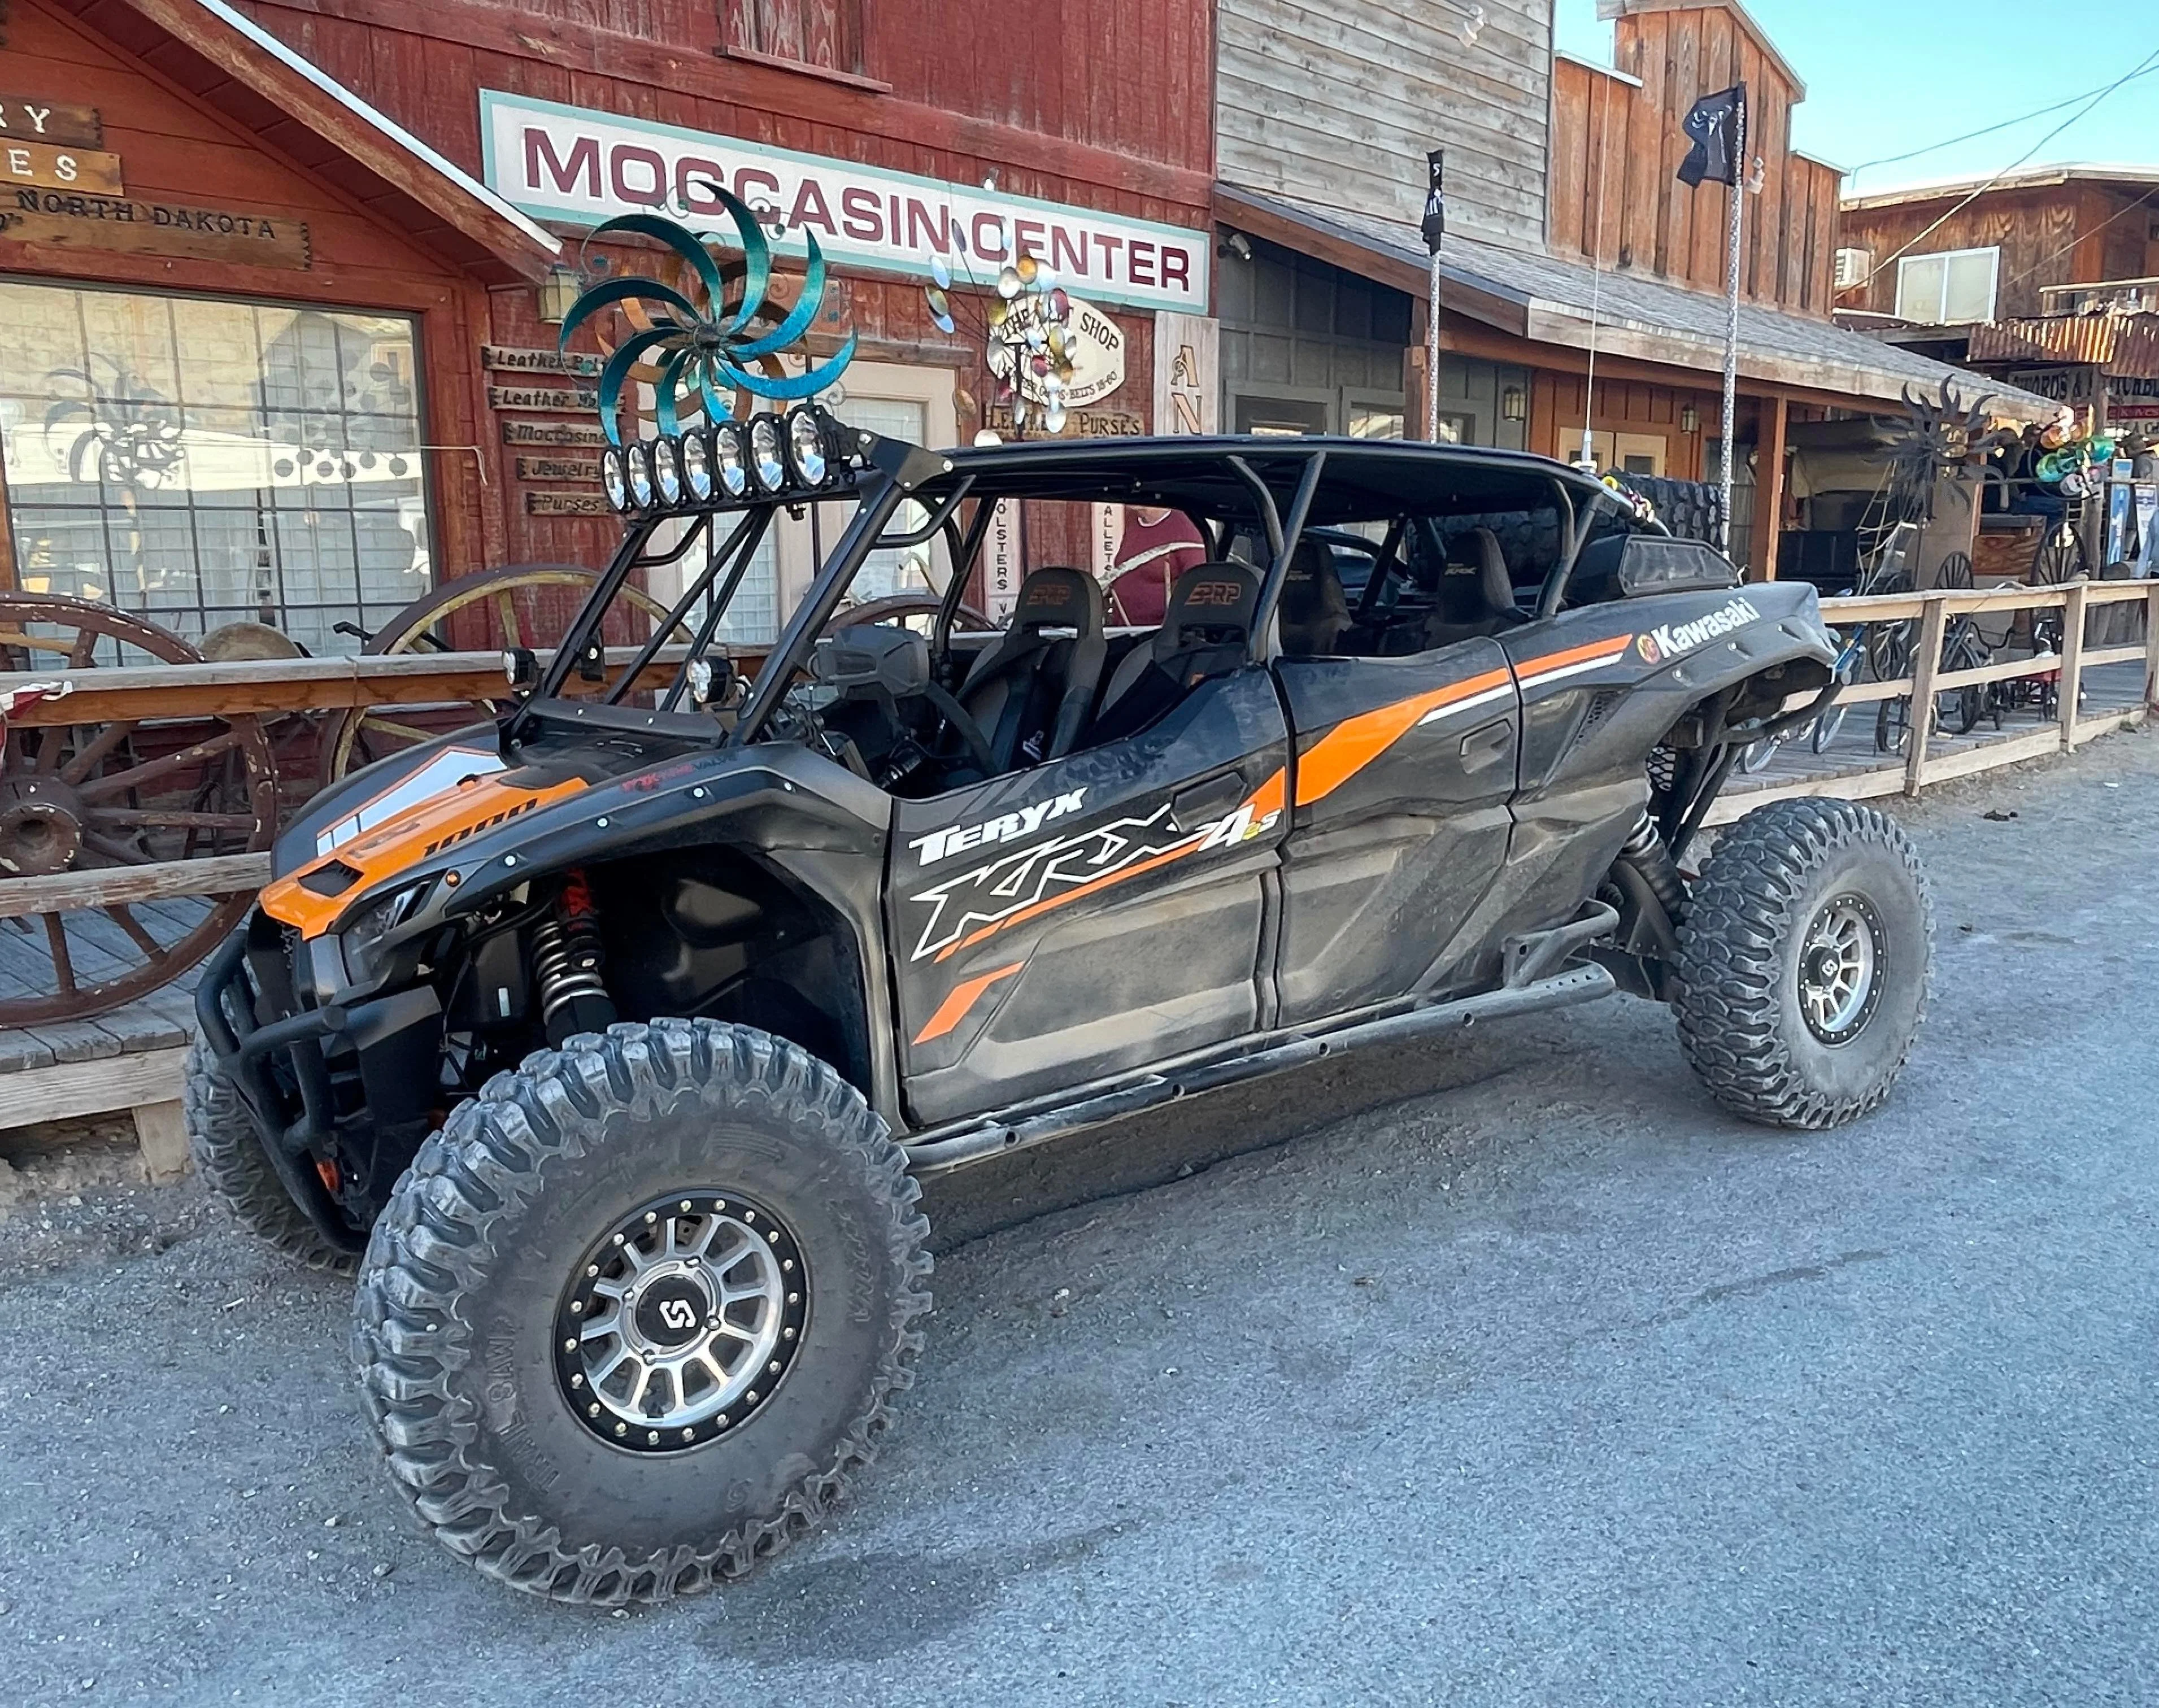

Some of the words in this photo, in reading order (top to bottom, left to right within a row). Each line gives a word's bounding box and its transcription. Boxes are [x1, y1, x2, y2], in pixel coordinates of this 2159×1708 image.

[17, 189, 135, 222] NORTH
[153, 207, 276, 239] DAKOTA
[524, 128, 950, 254] MOCCASIN
[972, 212, 1189, 292] CENTER
[1079, 311, 1120, 351] SHOP
[503, 390, 569, 407] Leather
[1080, 412, 1140, 436] PURSES
[532, 460, 600, 479] Jewelry
[542, 495, 600, 511] Purses
[1650, 596, 1761, 659] Kawasaki
[908, 786, 1089, 867] TERYX
